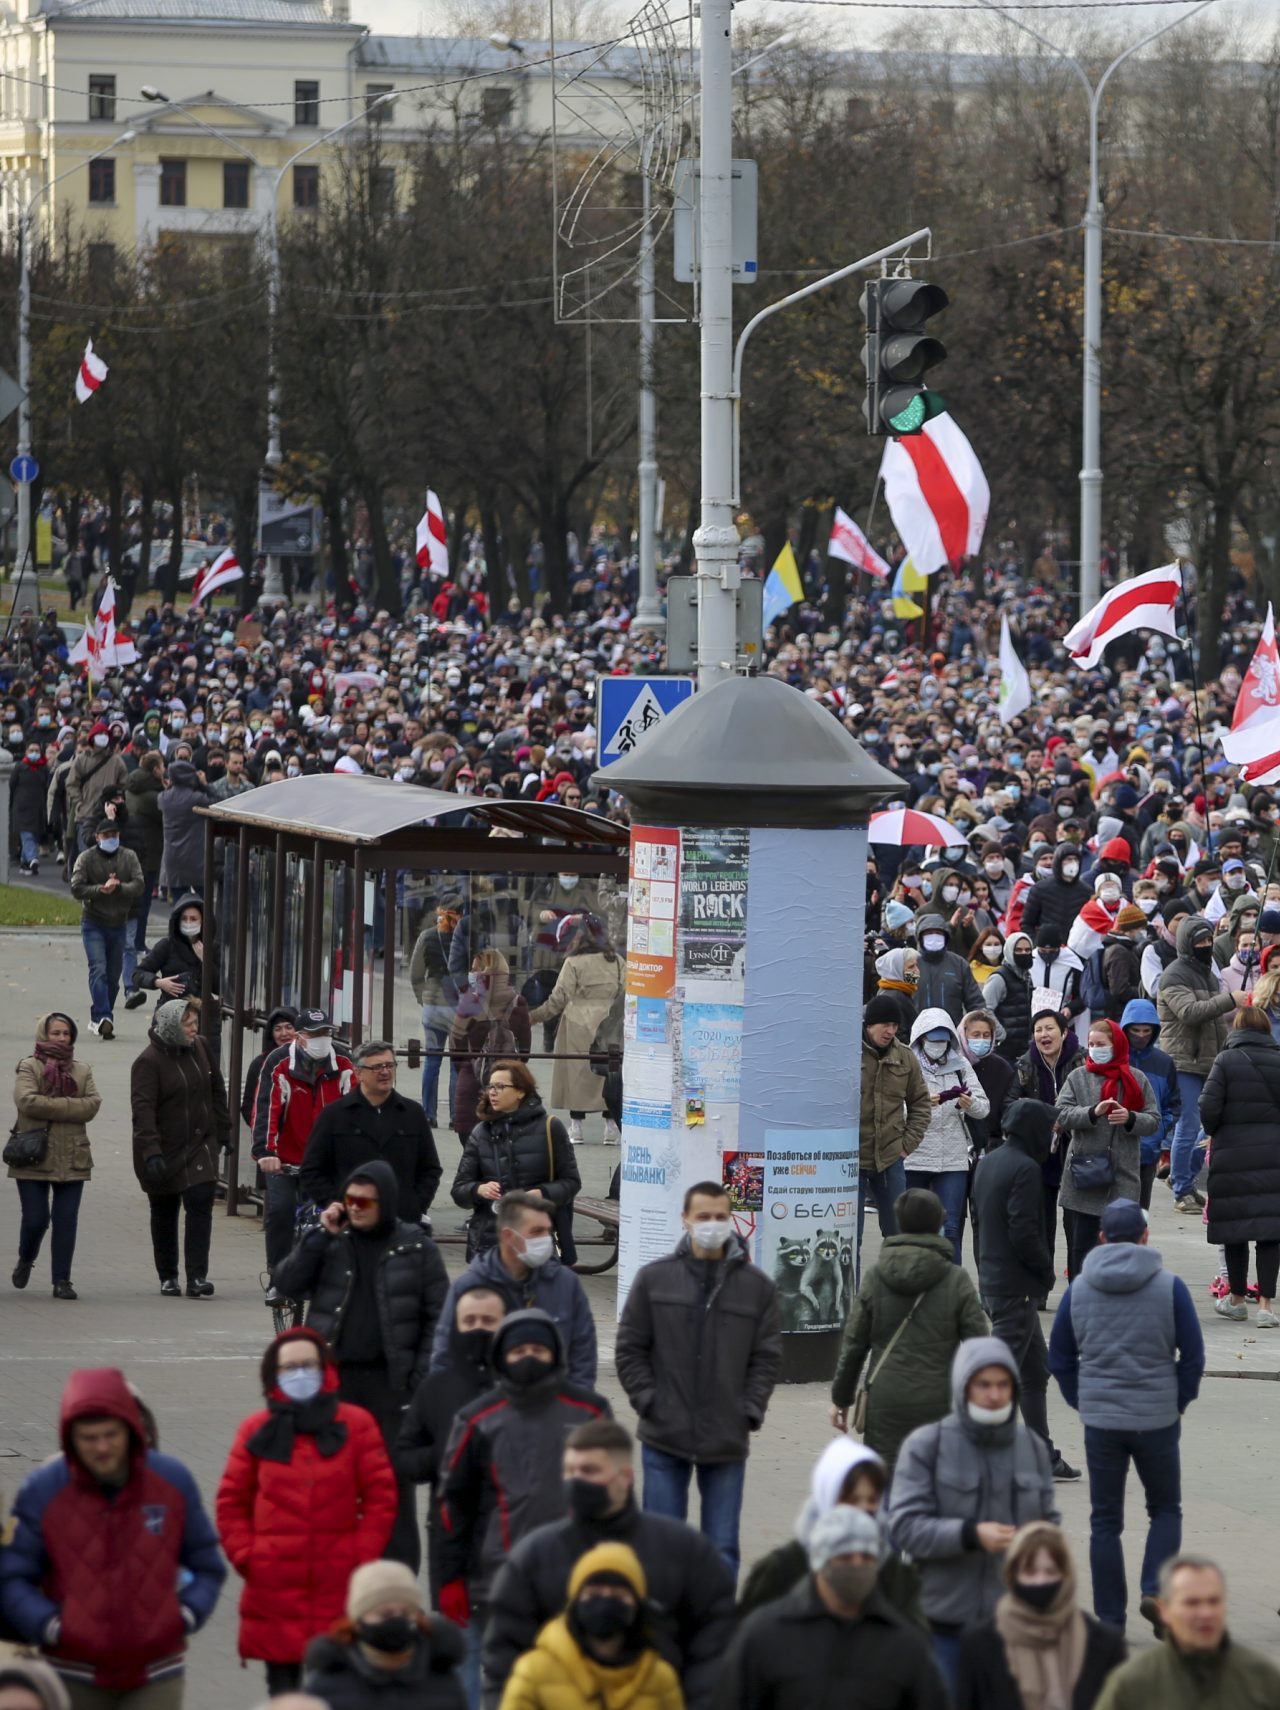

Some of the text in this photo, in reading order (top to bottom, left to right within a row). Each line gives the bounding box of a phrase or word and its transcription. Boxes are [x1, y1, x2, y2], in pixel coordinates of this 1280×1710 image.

[681, 880, 746, 892] WORLD LEGENDS
[693, 893, 745, 918] ROCK
[692, 1030, 721, 1041] 2020
[627, 1145, 652, 1165] ДЗЕНЬ
[767, 1150, 812, 1161] Позаботься
[814, 1150, 821, 1161] об
[772, 1165, 789, 1176] уже
[790, 1163, 817, 1176] СЕЙЧАС
[767, 1185, 788, 1195] Сдай
[789, 1186, 814, 1195] старую
